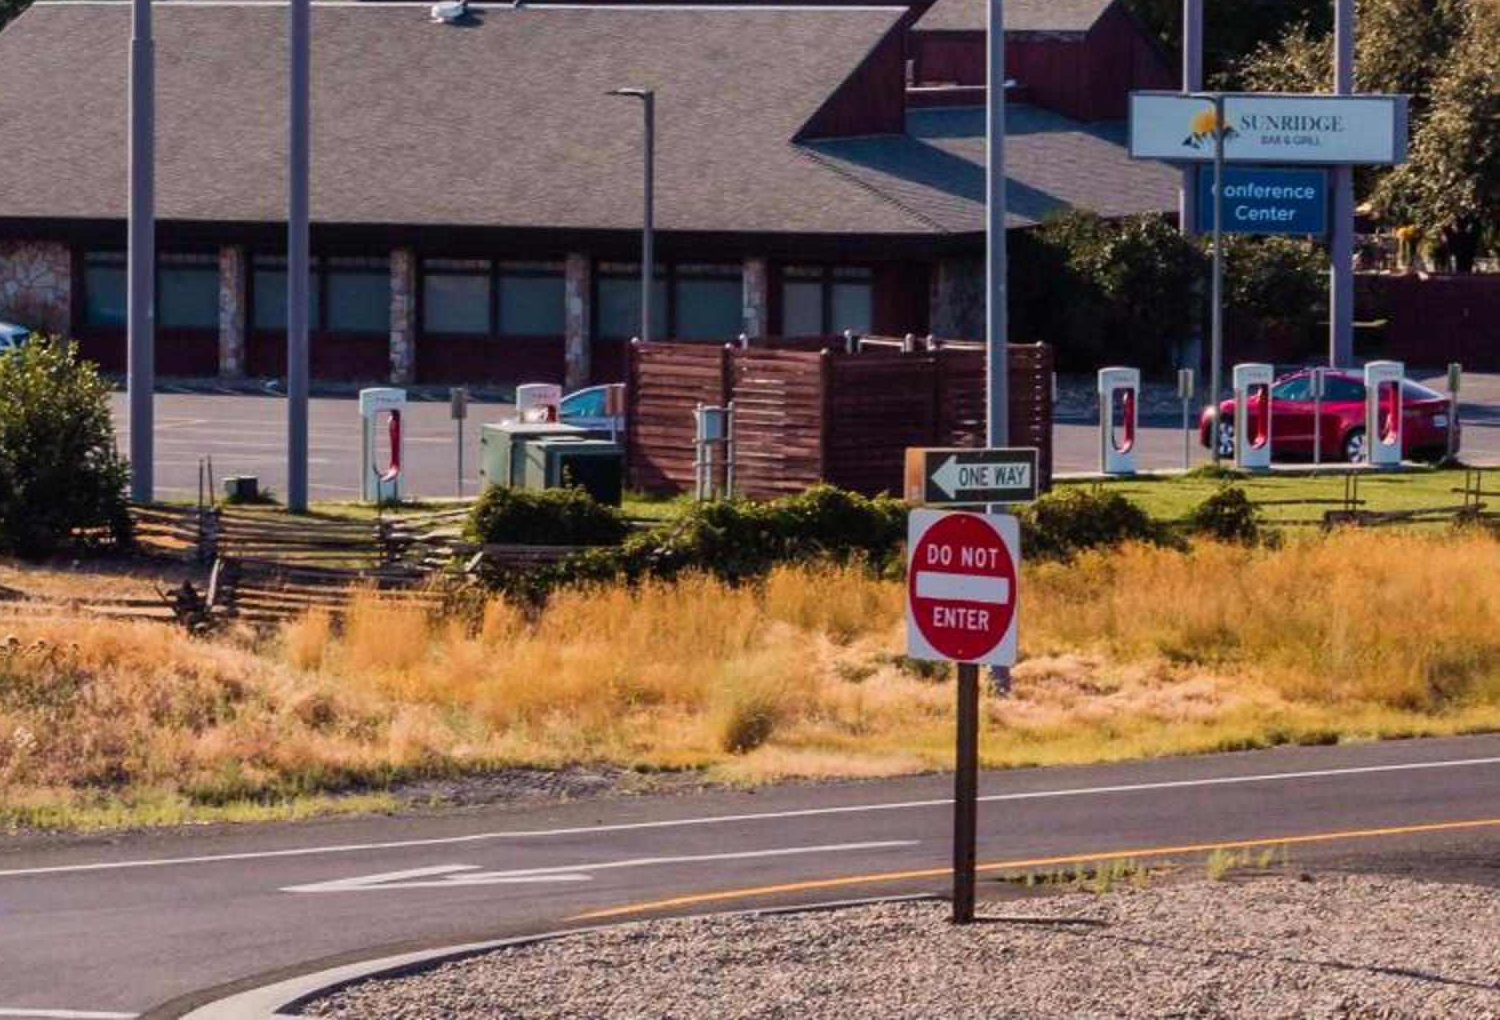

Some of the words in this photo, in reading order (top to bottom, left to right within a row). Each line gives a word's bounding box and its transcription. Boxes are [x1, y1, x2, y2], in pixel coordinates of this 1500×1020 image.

[1240, 115, 1343, 134] SUNRIDGE
[1260, 135, 1282, 146] BAR
[1293, 135, 1321, 146] GRILL
[1235, 205, 1296, 222] Center
[958, 467, 989, 487] ONE
[993, 465, 1026, 485] WAY
[927, 544, 952, 566] DO
[961, 547, 999, 568] NOT
[933, 607, 989, 631] ENTER
